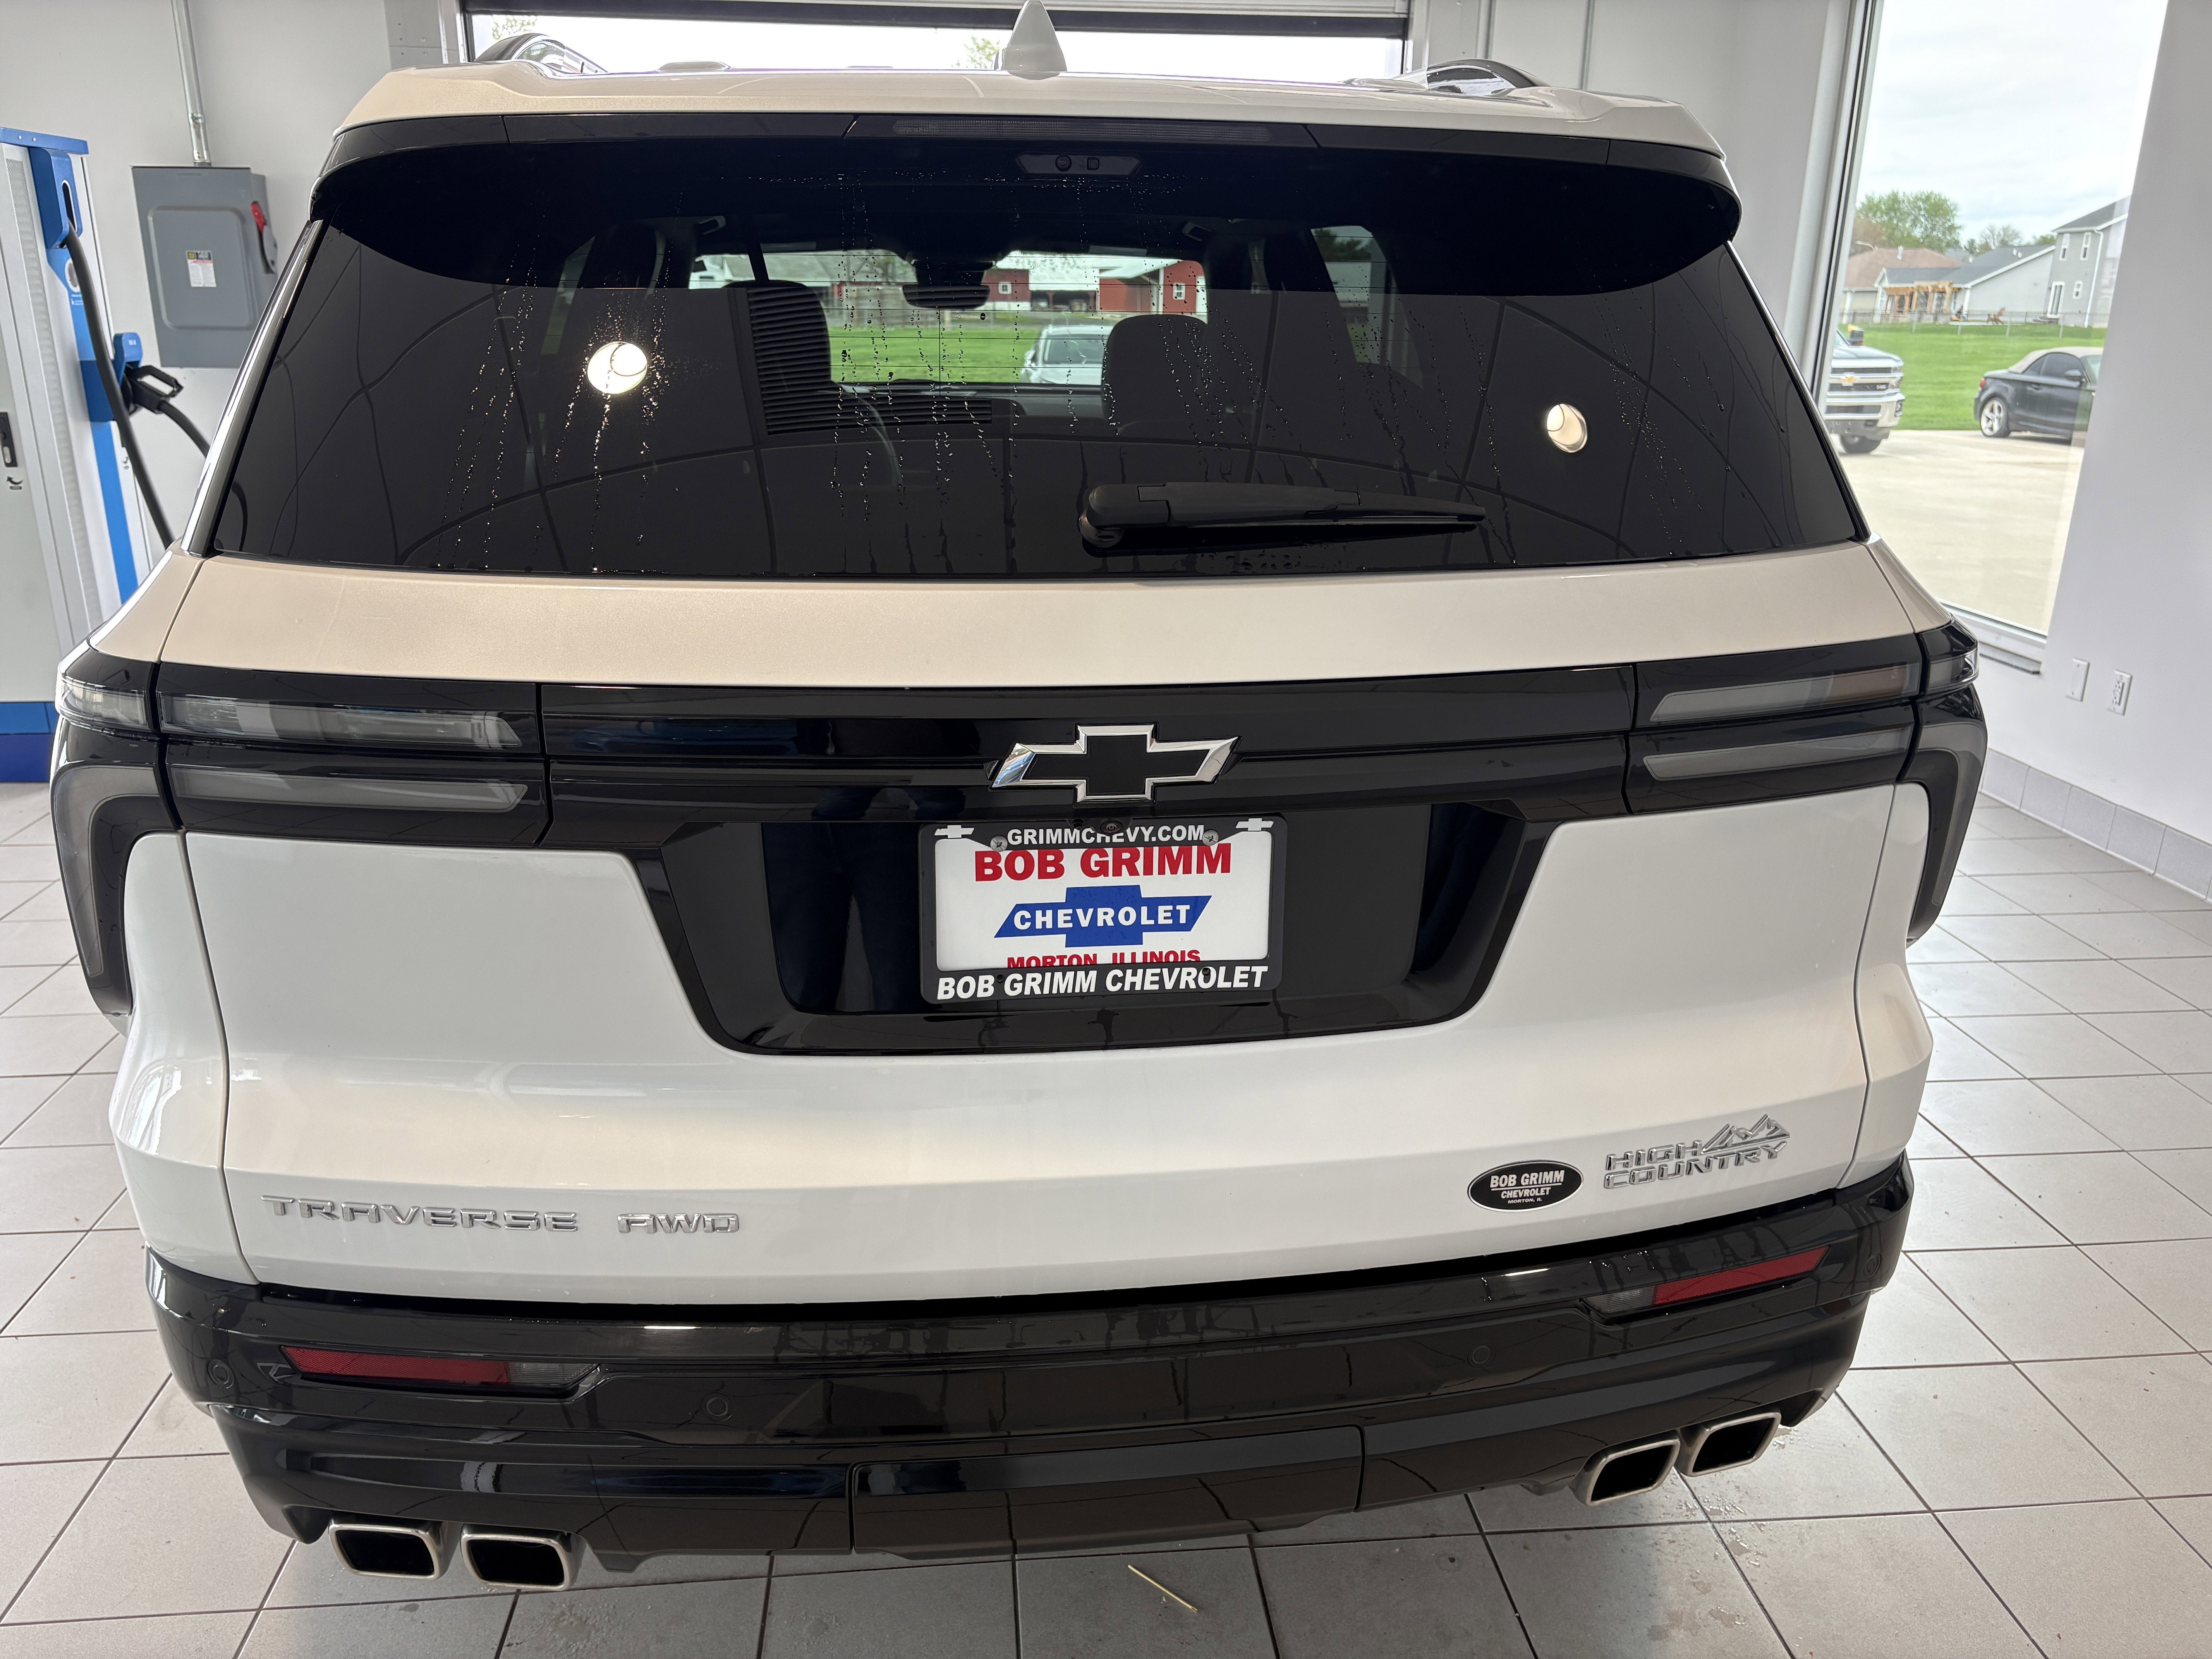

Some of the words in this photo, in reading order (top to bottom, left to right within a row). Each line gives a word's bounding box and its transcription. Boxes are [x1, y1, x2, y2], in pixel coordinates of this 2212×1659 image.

[1007, 825, 1204, 845] GRIMMCHEVY.COM
[975, 849, 1065, 881] BOB
[1080, 843, 1231, 878] GRIMM
[1013, 905, 1190, 929] CHEVROLET
[937, 975, 995, 1000] BOB
[1004, 970, 1097, 996] GRIMM
[1106, 965, 1269, 991] CHEVROLET
[1604, 1141, 1787, 1189] COUNTRY
[1606, 1140, 1702, 1171] HIGH
[1490, 1175, 1516, 1188] BOB
[1521, 1170, 1565, 1185] GRIMM
[1501, 1187, 1551, 1199] CHEVROLET
[261, 1195, 578, 1232] TRAVERSE
[617, 1213, 740, 1234] AWD
